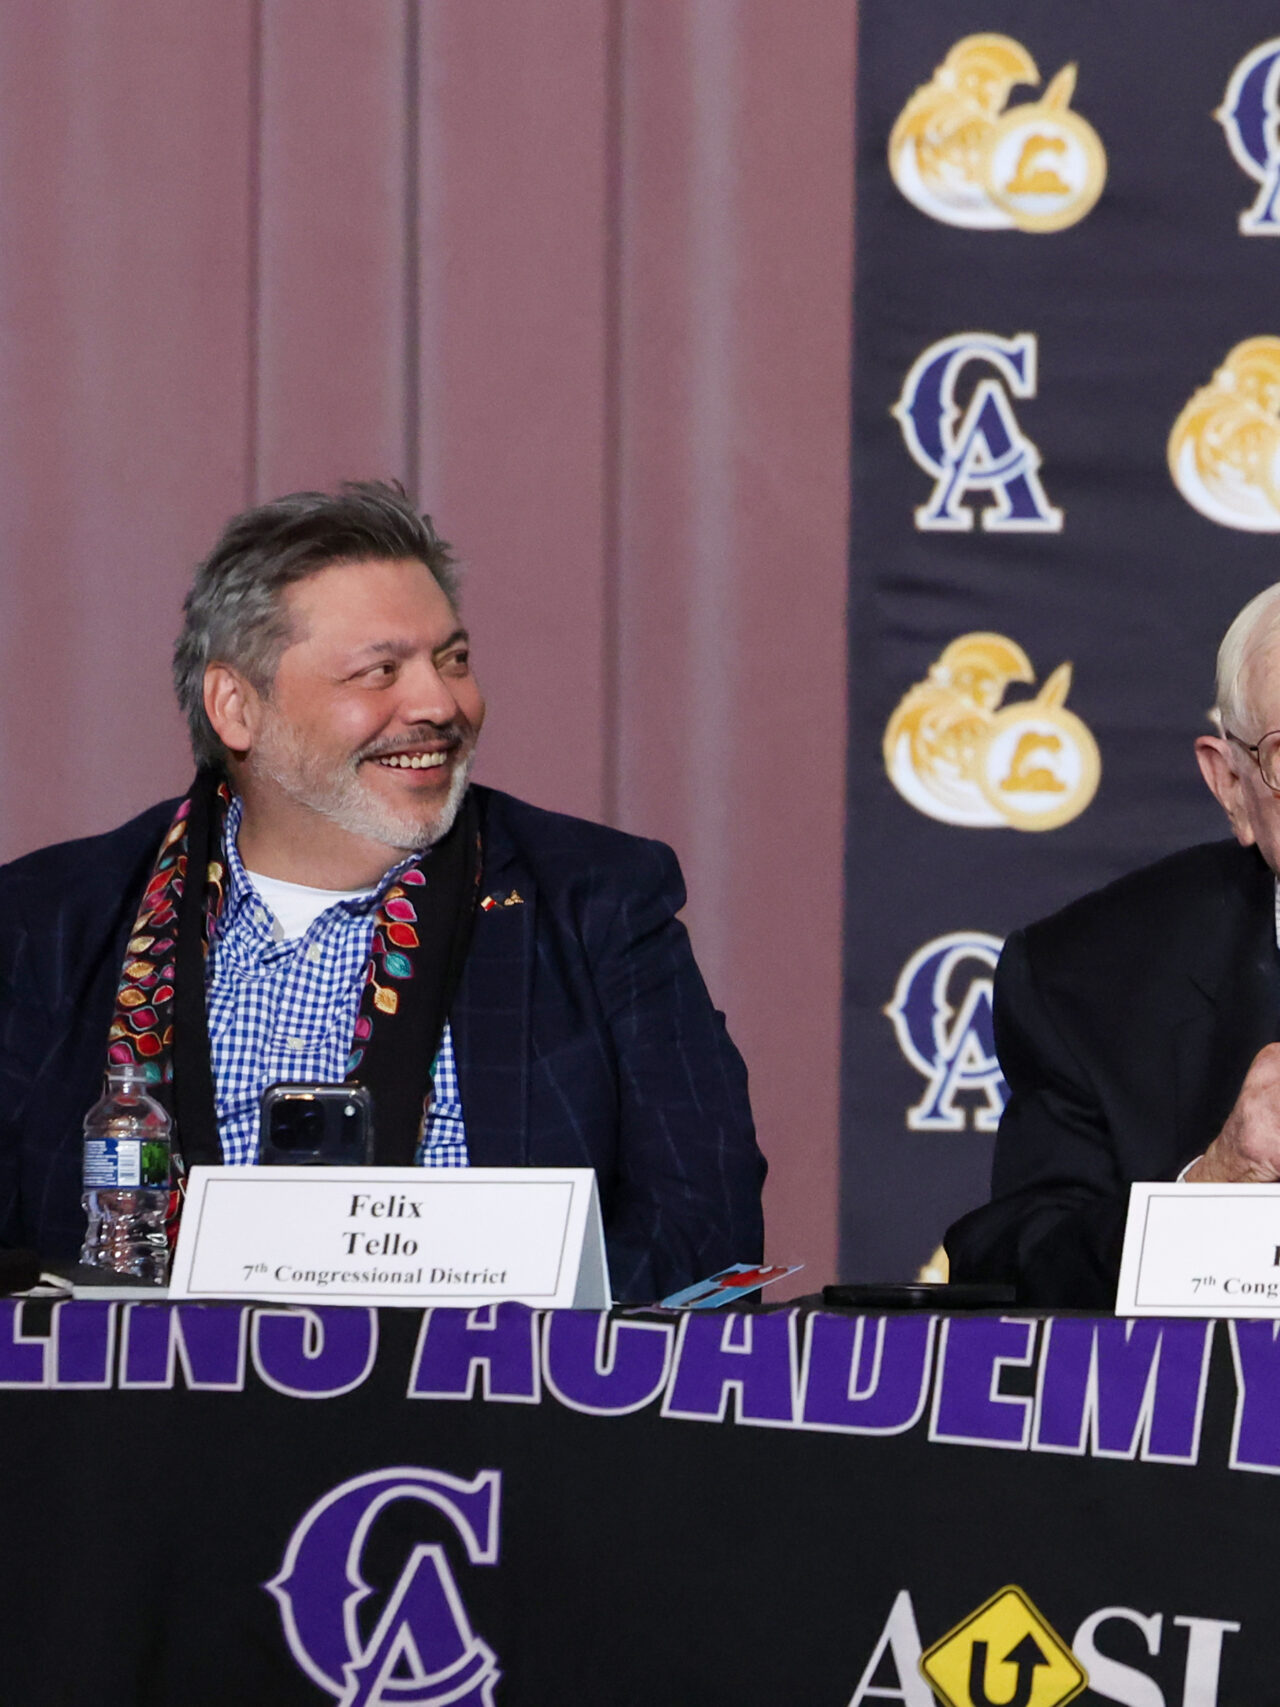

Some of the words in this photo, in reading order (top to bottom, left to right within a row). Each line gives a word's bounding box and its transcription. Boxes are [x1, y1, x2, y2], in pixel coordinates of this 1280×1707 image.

[891, 332, 1064, 534] CA
[348, 1194, 423, 1218] Felix
[342, 1231, 419, 1256] Tello
[242, 1263, 268, 1281] 7th
[274, 1266, 422, 1286] Congressional
[429, 1267, 507, 1284] District
[1191, 1275, 1216, 1294] 7th
[262, 1466, 502, 1707] CA
